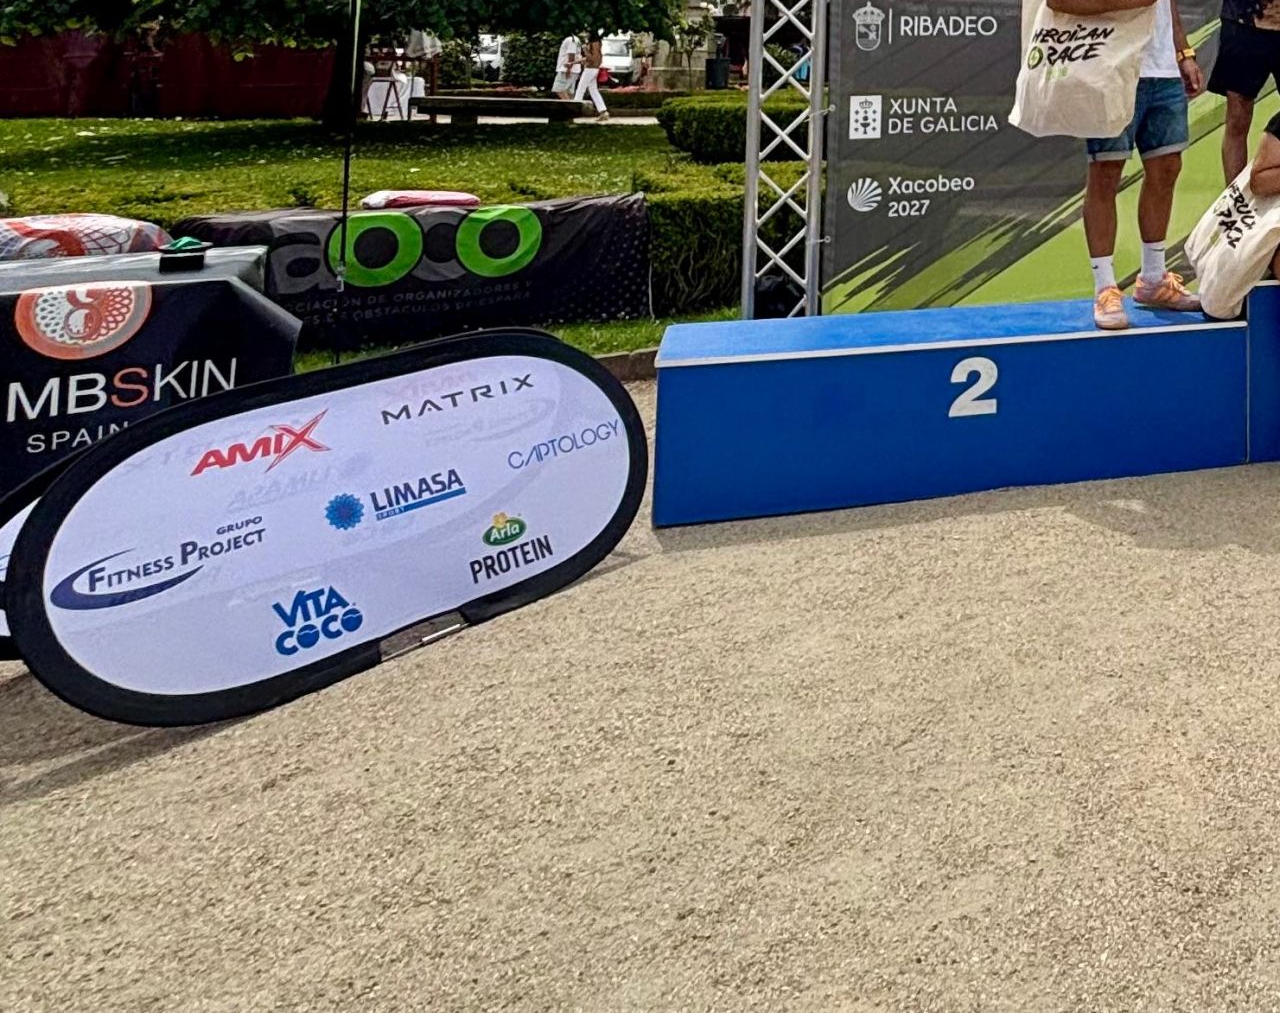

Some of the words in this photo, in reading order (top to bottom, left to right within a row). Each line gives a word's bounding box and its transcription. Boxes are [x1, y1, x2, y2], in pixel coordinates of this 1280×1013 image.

[900, 15, 998, 37] RIBADEO
[1047, 41, 1106, 66] RACE
[888, 117, 914, 134] DE
[920, 115, 999, 134] GALICIA
[889, 97, 958, 115] XUNTA
[888, 175, 975, 195] Xacobeo
[888, 199, 931, 217] 2027
[6, 357, 237, 423] MBSKIN
[381, 373, 535, 425] MATRIX
[948, 356, 999, 418] 2
[190, 408, 331, 475] AMIX
[507, 418, 621, 470] CAPTOLOGY
[370, 468, 464, 512] LIMASA
[216, 515, 263, 537] GRUPO
[488, 520, 521, 543] Arla
[469, 534, 555, 584] PROTEIN
[272, 585, 351, 629] VITA
[275, 607, 365, 657] COCO
